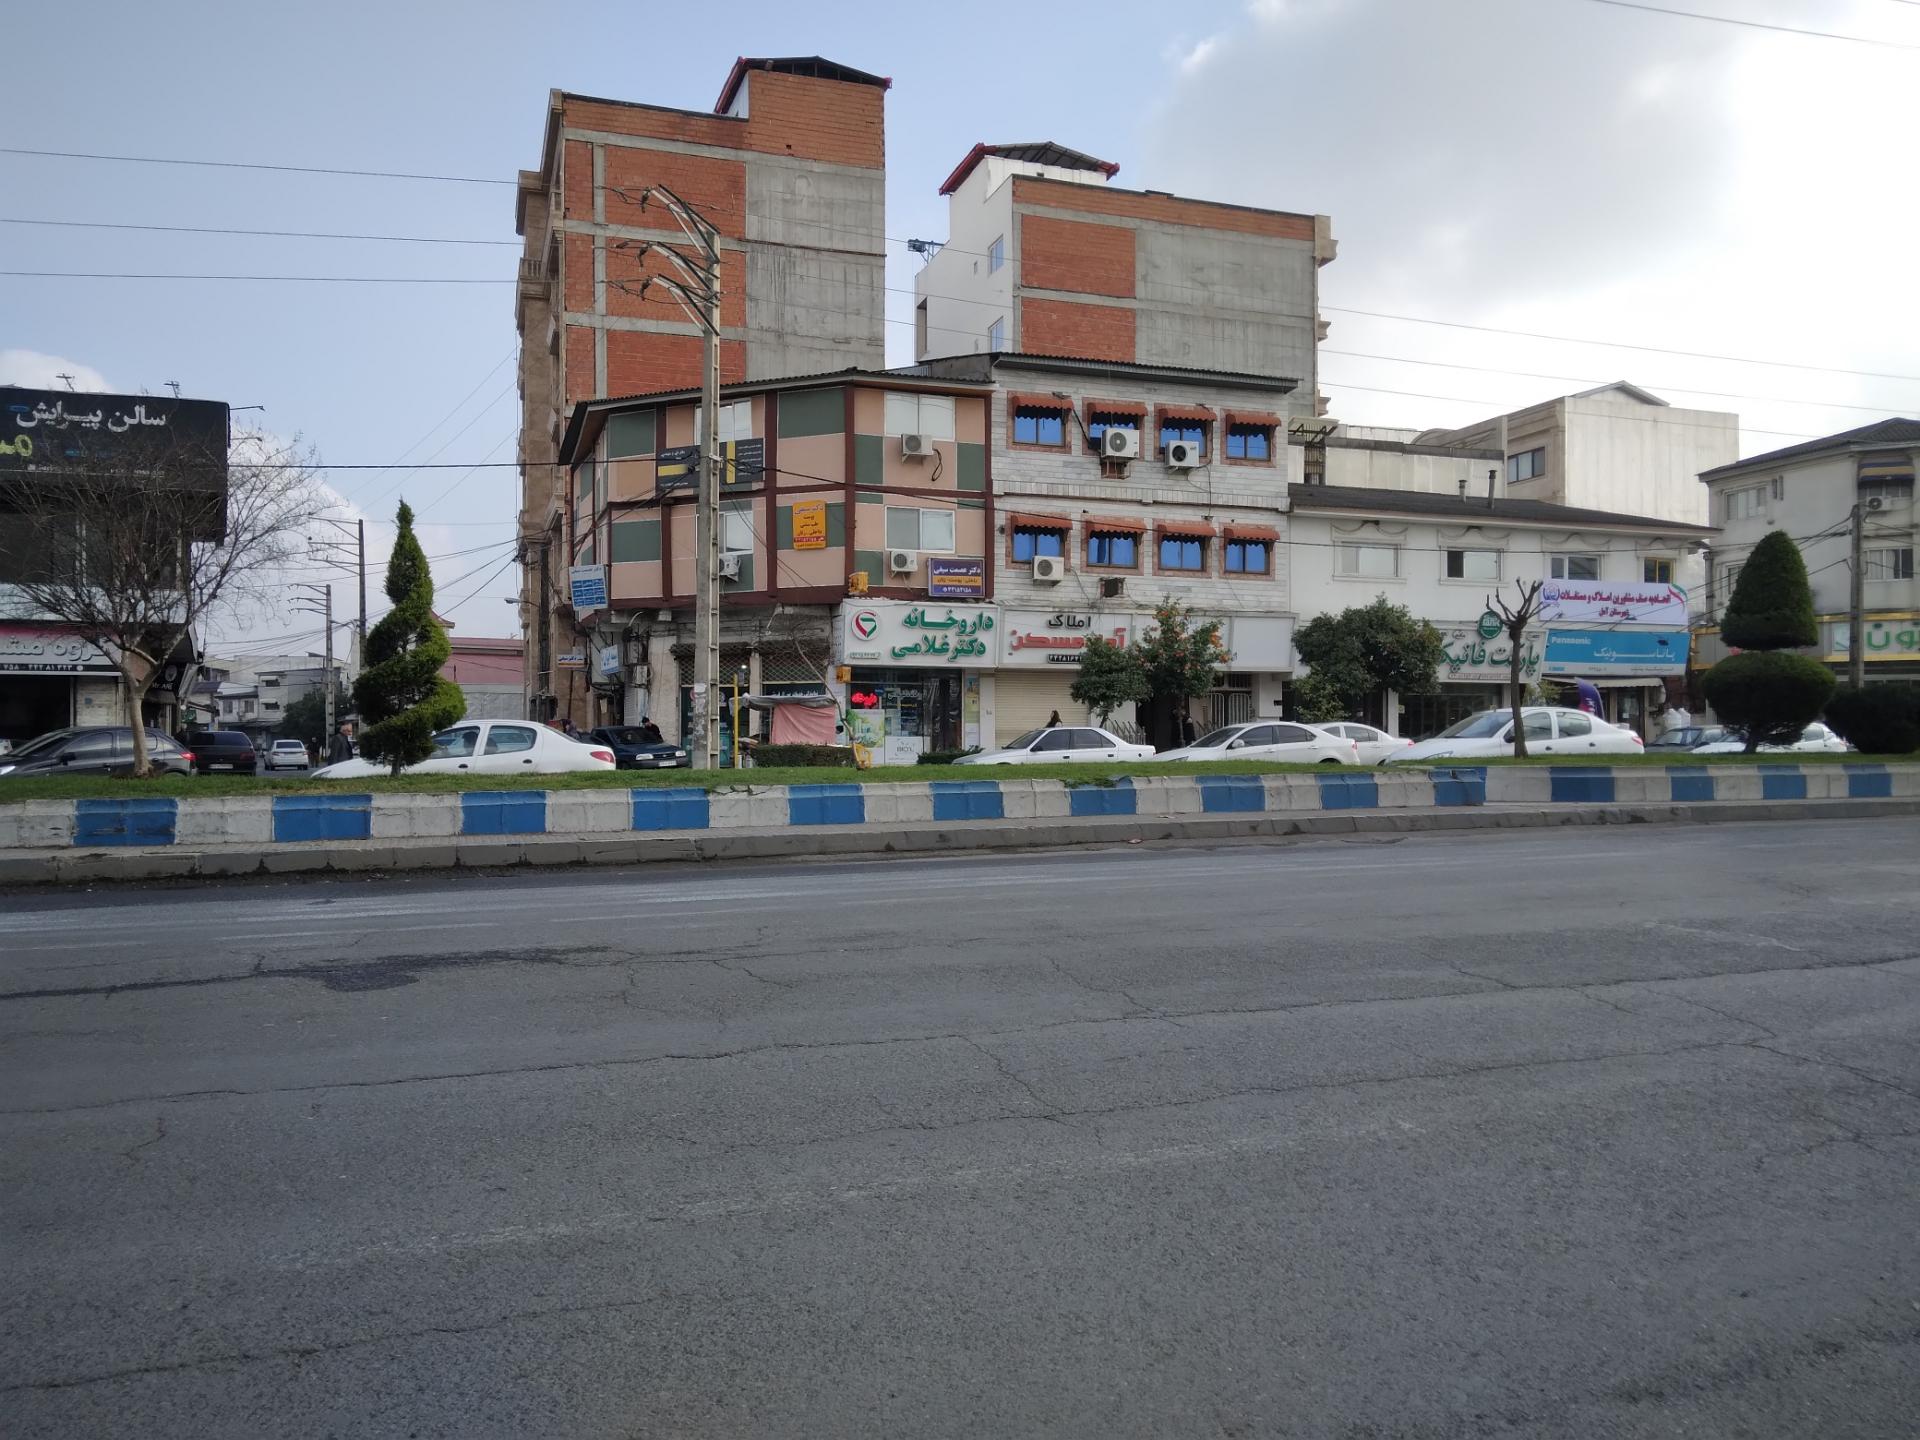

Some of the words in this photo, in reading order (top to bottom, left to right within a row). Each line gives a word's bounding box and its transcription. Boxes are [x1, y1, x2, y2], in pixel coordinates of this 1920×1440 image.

[17, 401, 103, 430] پیرایش
[108, 404, 166, 432] سالن
[968, 565, 981, 575] دکتر
[1592, 591, 1612, 601] املاک
[1599, 607, 1609, 616] آمل
[903, 607, 994, 636] داروخانه
[1047, 614, 1092, 628] املاک
[891, 634, 950, 659] غلامی
[1010, 629, 1085, 651] مسکن
[1551, 636, 1592, 645] Panasonic
[948, 638, 987, 661] دکتر
[1594, 647, 1676, 662] پاناسونیک
